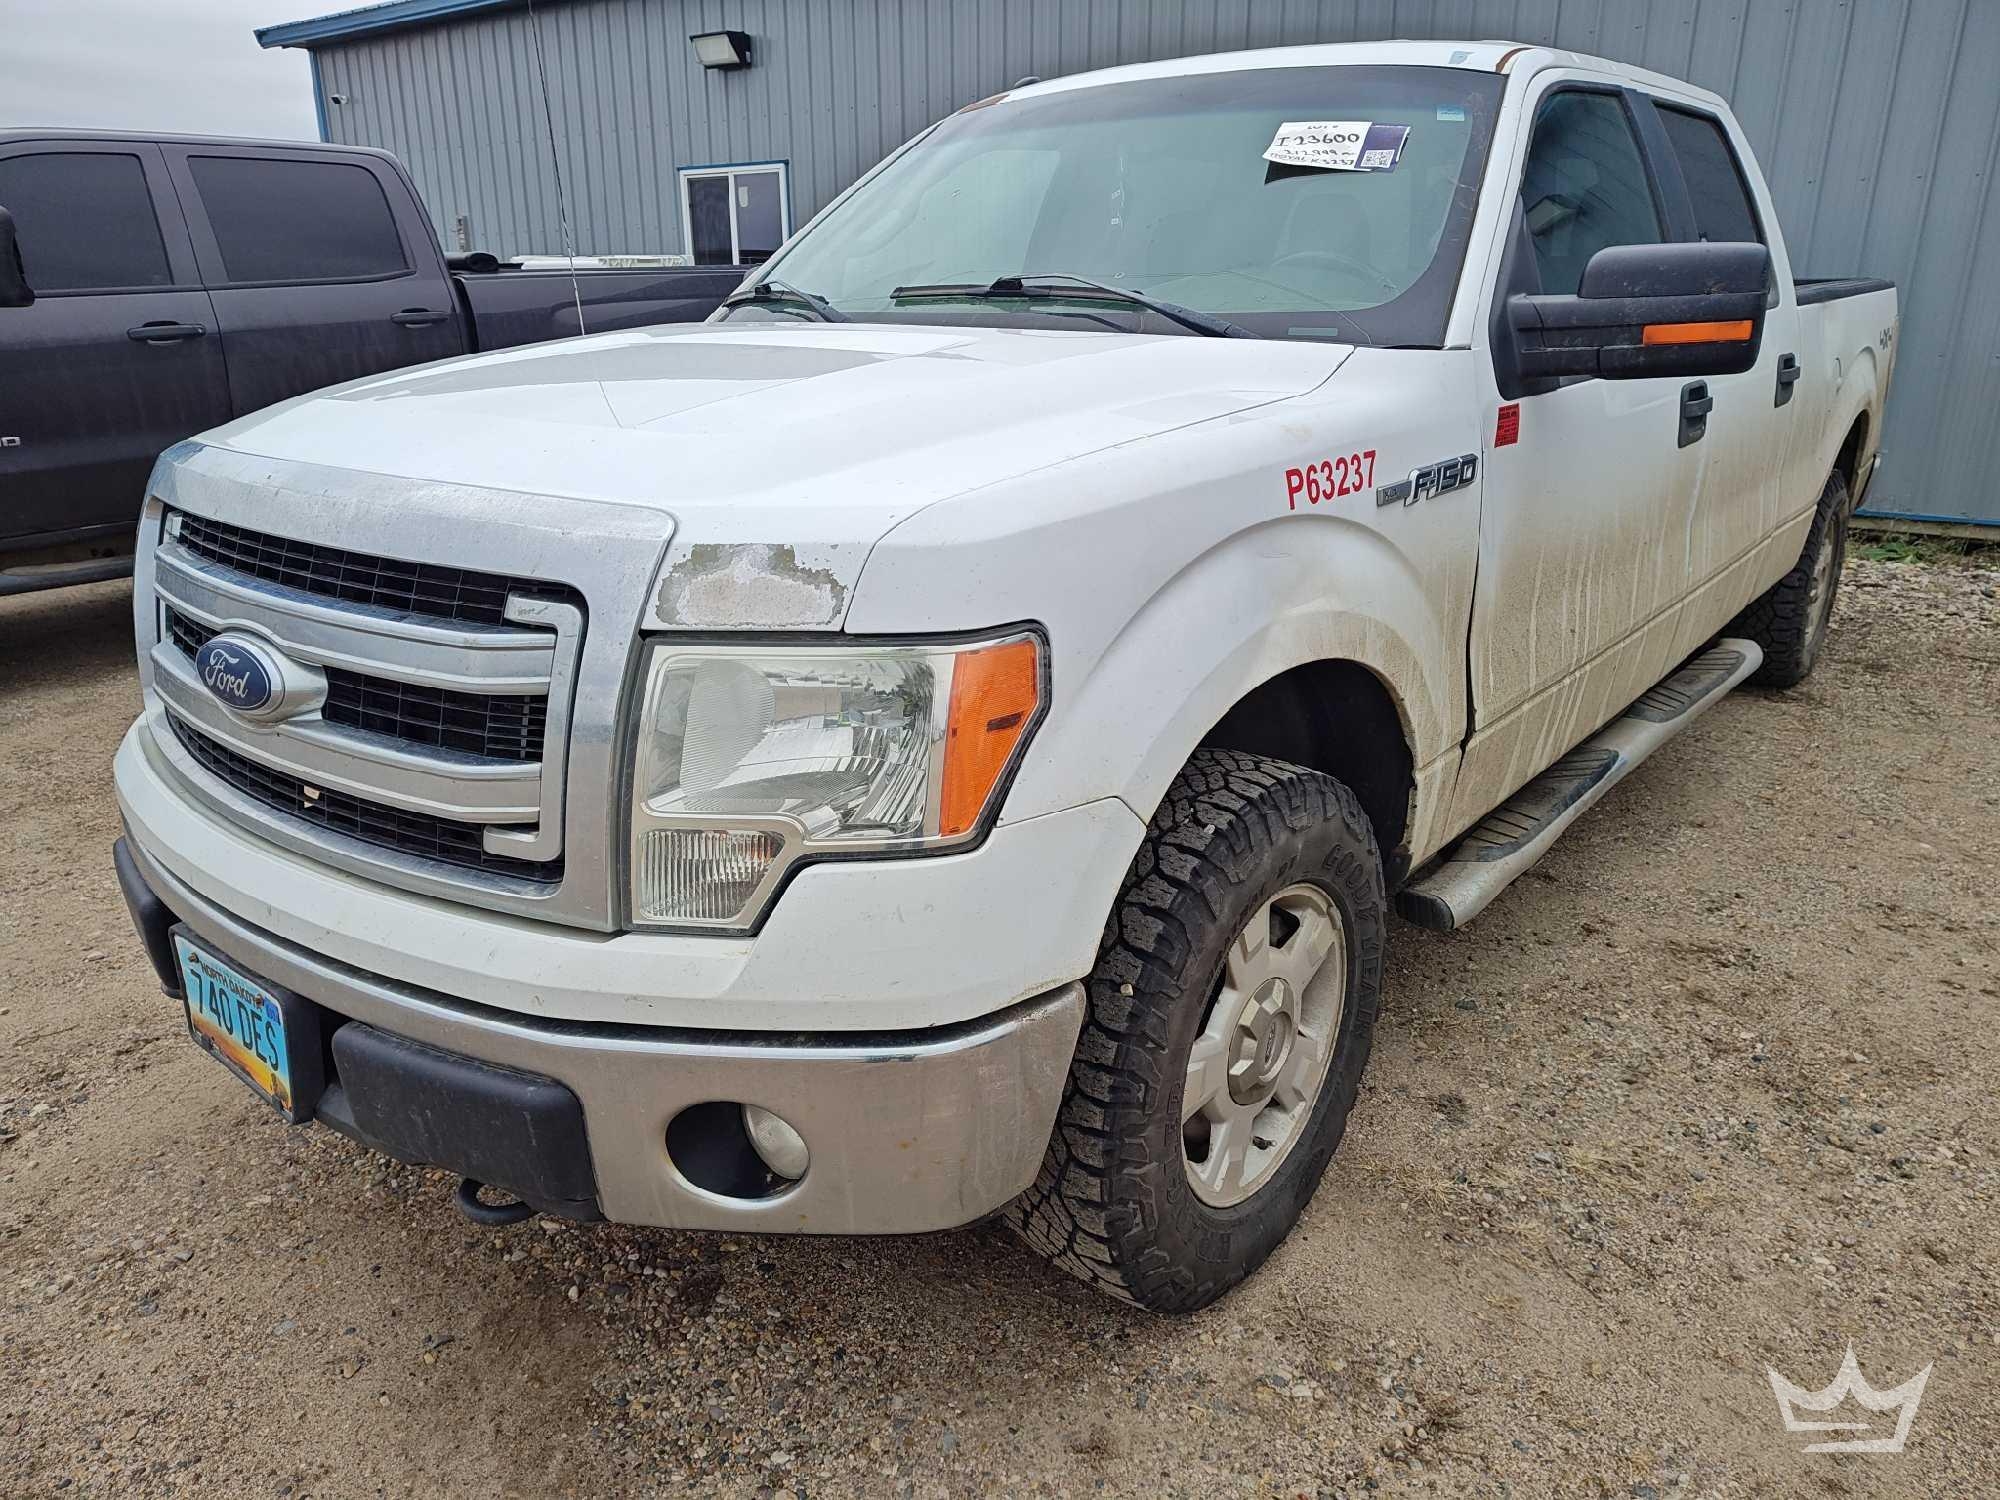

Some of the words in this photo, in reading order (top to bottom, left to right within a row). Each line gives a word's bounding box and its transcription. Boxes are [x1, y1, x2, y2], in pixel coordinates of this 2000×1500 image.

[1285, 450, 1376, 510] P63237
[205, 648, 250, 698] Ford
[200, 962, 228, 986] NORTH
[190, 968, 234, 1036] 740
[236, 1000, 279, 1072] DES
